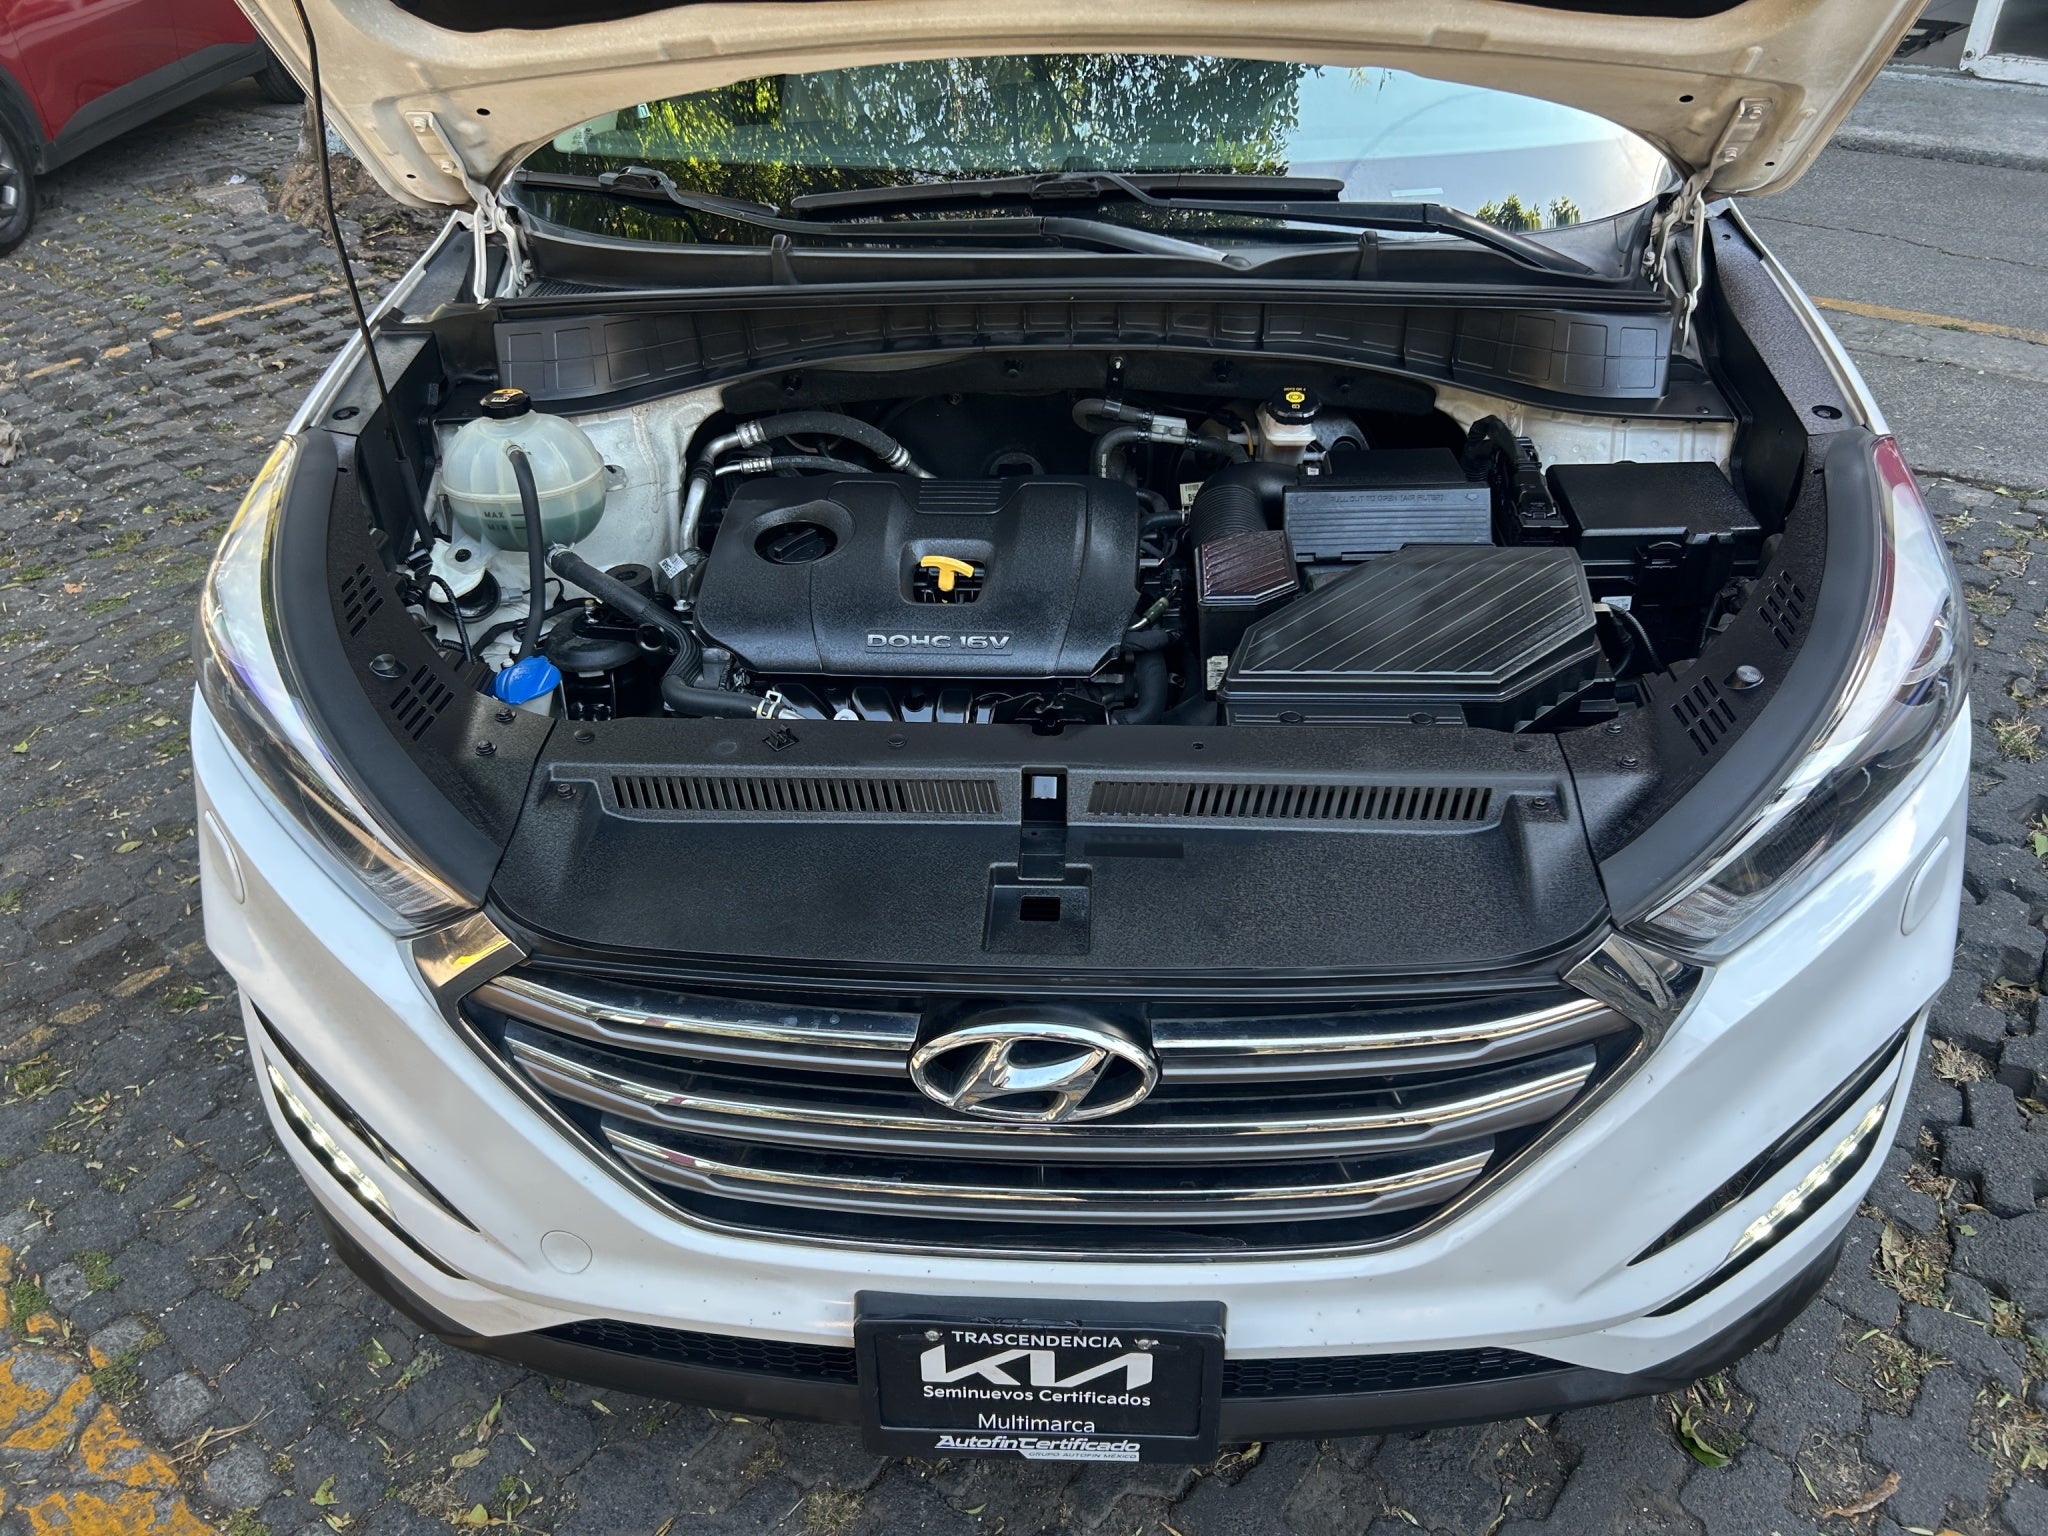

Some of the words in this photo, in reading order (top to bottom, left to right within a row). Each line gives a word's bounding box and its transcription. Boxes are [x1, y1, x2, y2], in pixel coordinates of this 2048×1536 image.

[483, 511, 505, 519] MAX
[867, 634, 951, 648] DOHC
[960, 636, 1010, 649] 16V
[951, 1330, 1123, 1348] TRASCENDENCIA
[923, 1385, 1033, 1401] Seminuevos
[1039, 1389, 1151, 1407] Certificados
[978, 1413, 1096, 1433] Multimarca
